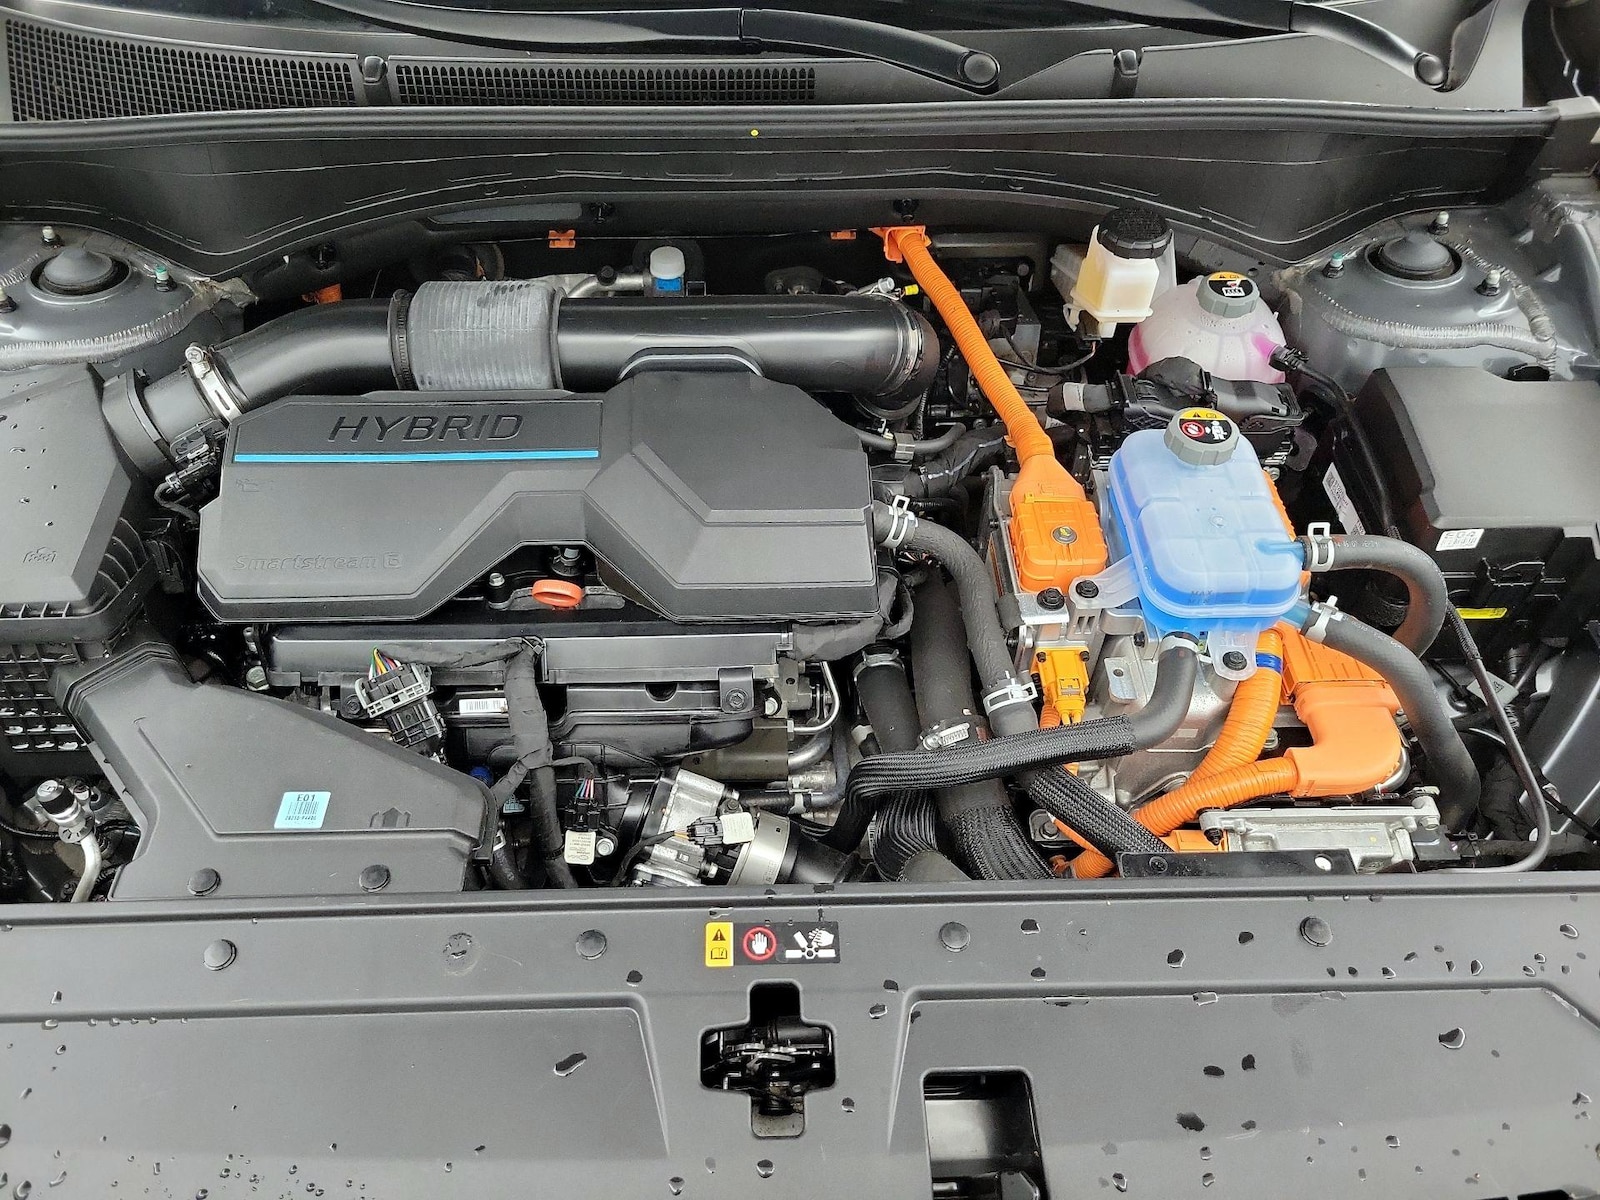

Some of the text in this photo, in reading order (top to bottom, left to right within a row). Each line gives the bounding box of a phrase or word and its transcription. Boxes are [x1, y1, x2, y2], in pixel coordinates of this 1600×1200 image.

[328, 414, 524, 442] HYBRID
[233, 554, 377, 570] Smartstream
[296, 793, 316, 802] E01
